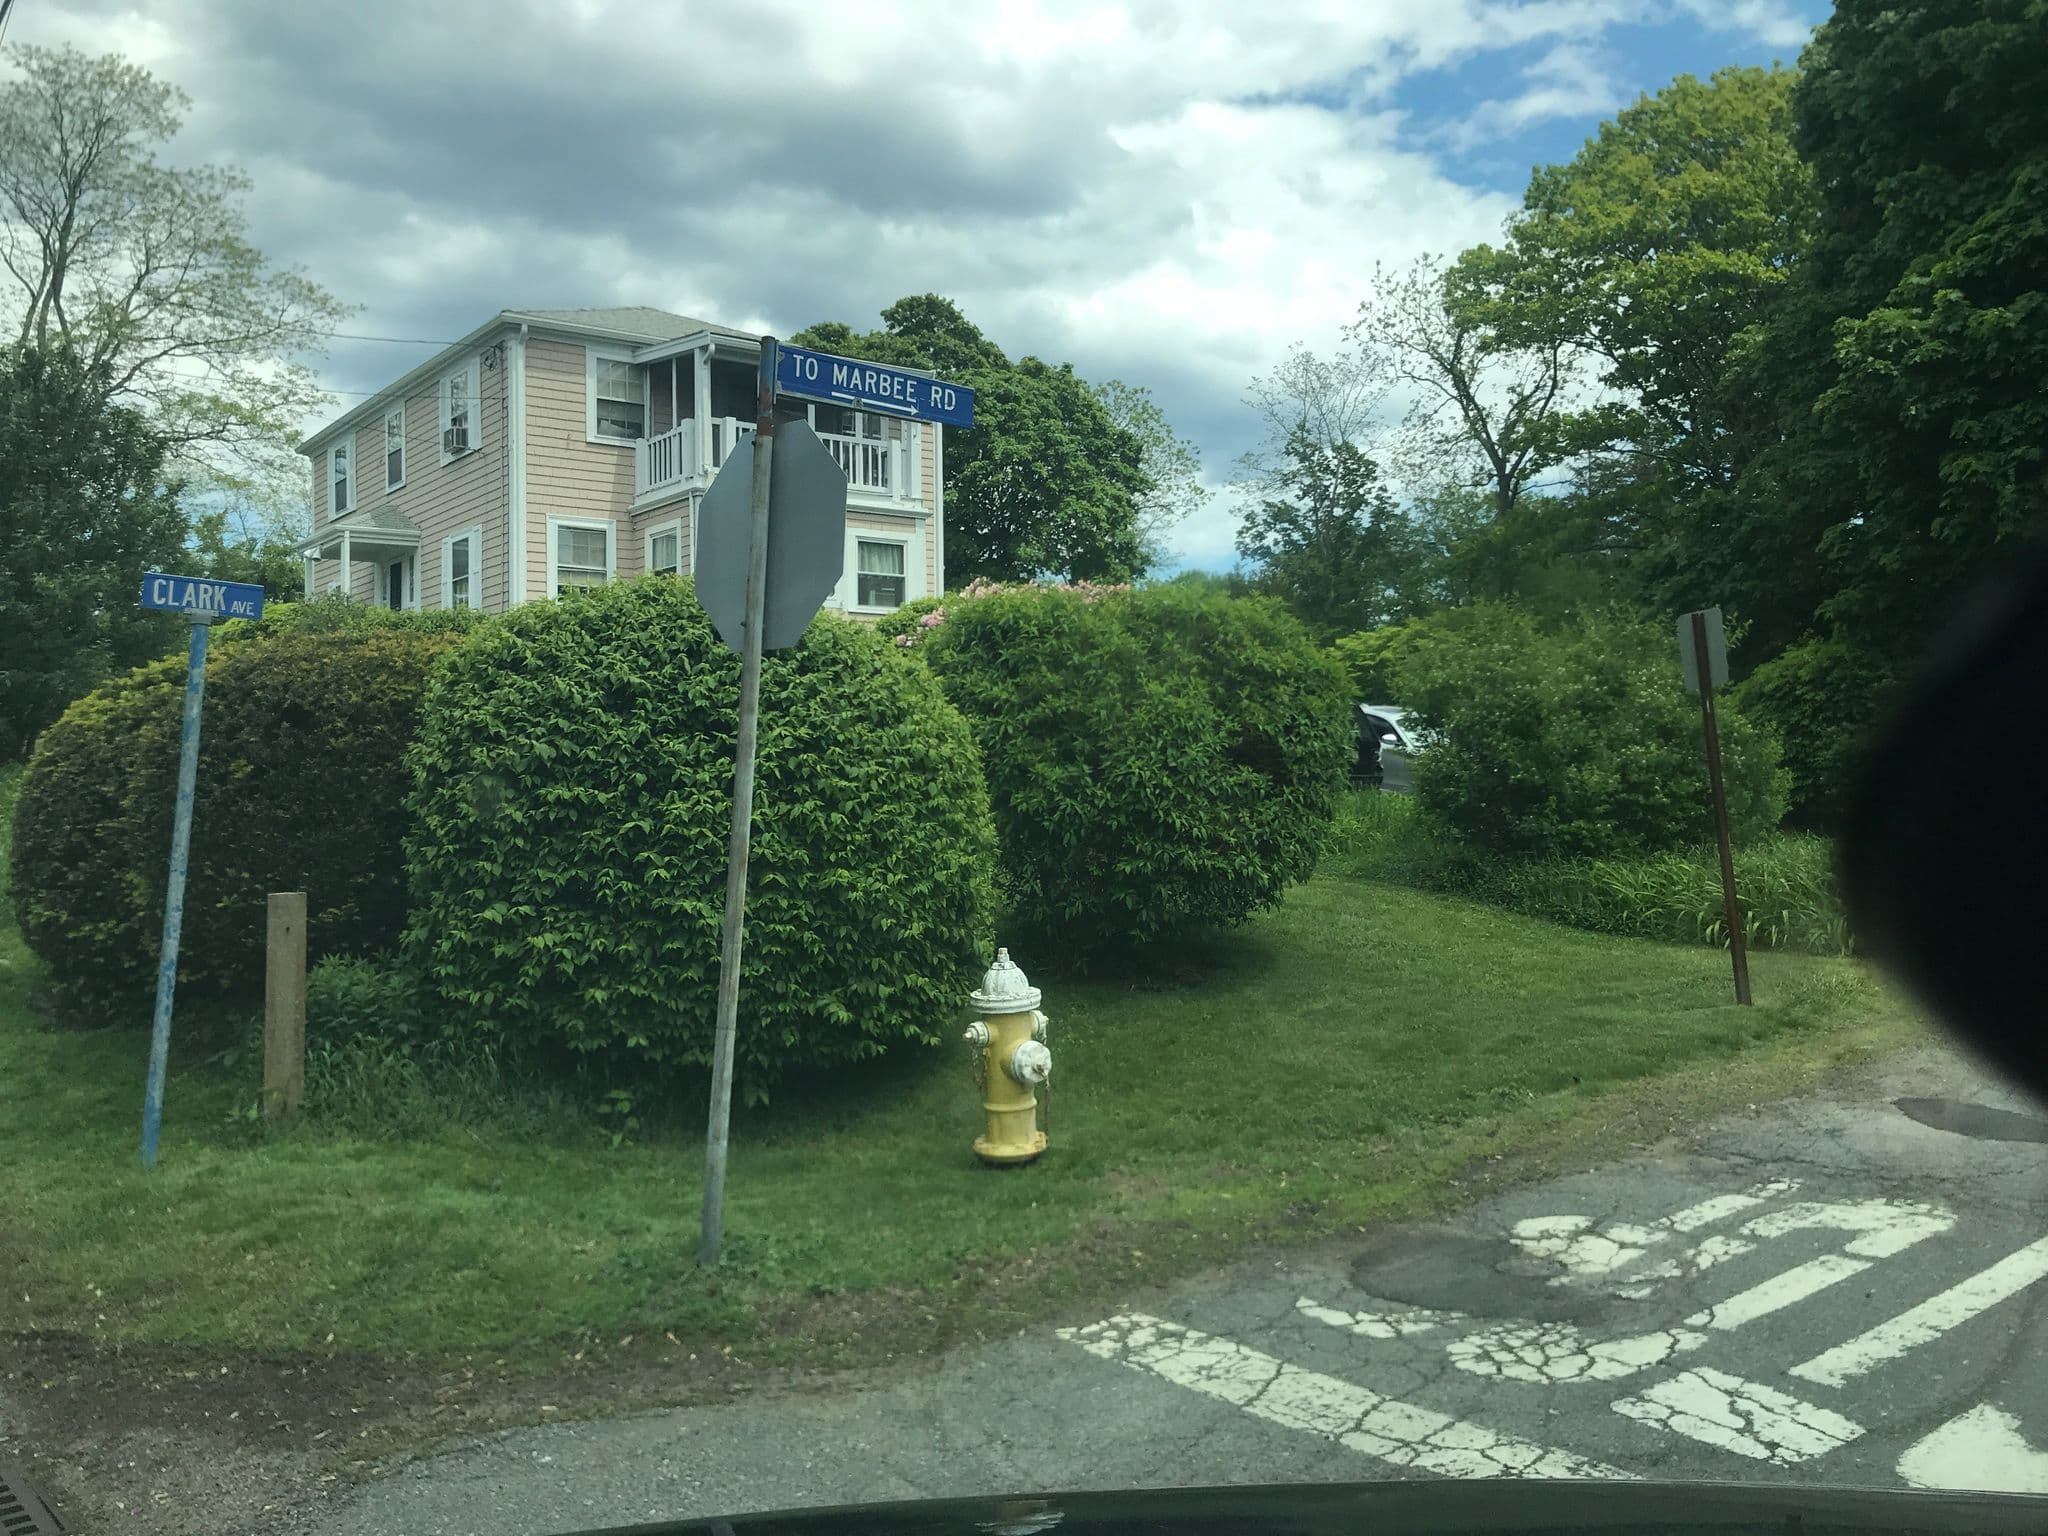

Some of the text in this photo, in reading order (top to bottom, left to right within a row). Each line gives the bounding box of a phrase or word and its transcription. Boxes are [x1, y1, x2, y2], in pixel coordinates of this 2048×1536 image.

[792, 354, 957, 411] TO MARBEE RD
[153, 578, 255, 617] CLARK AVE
